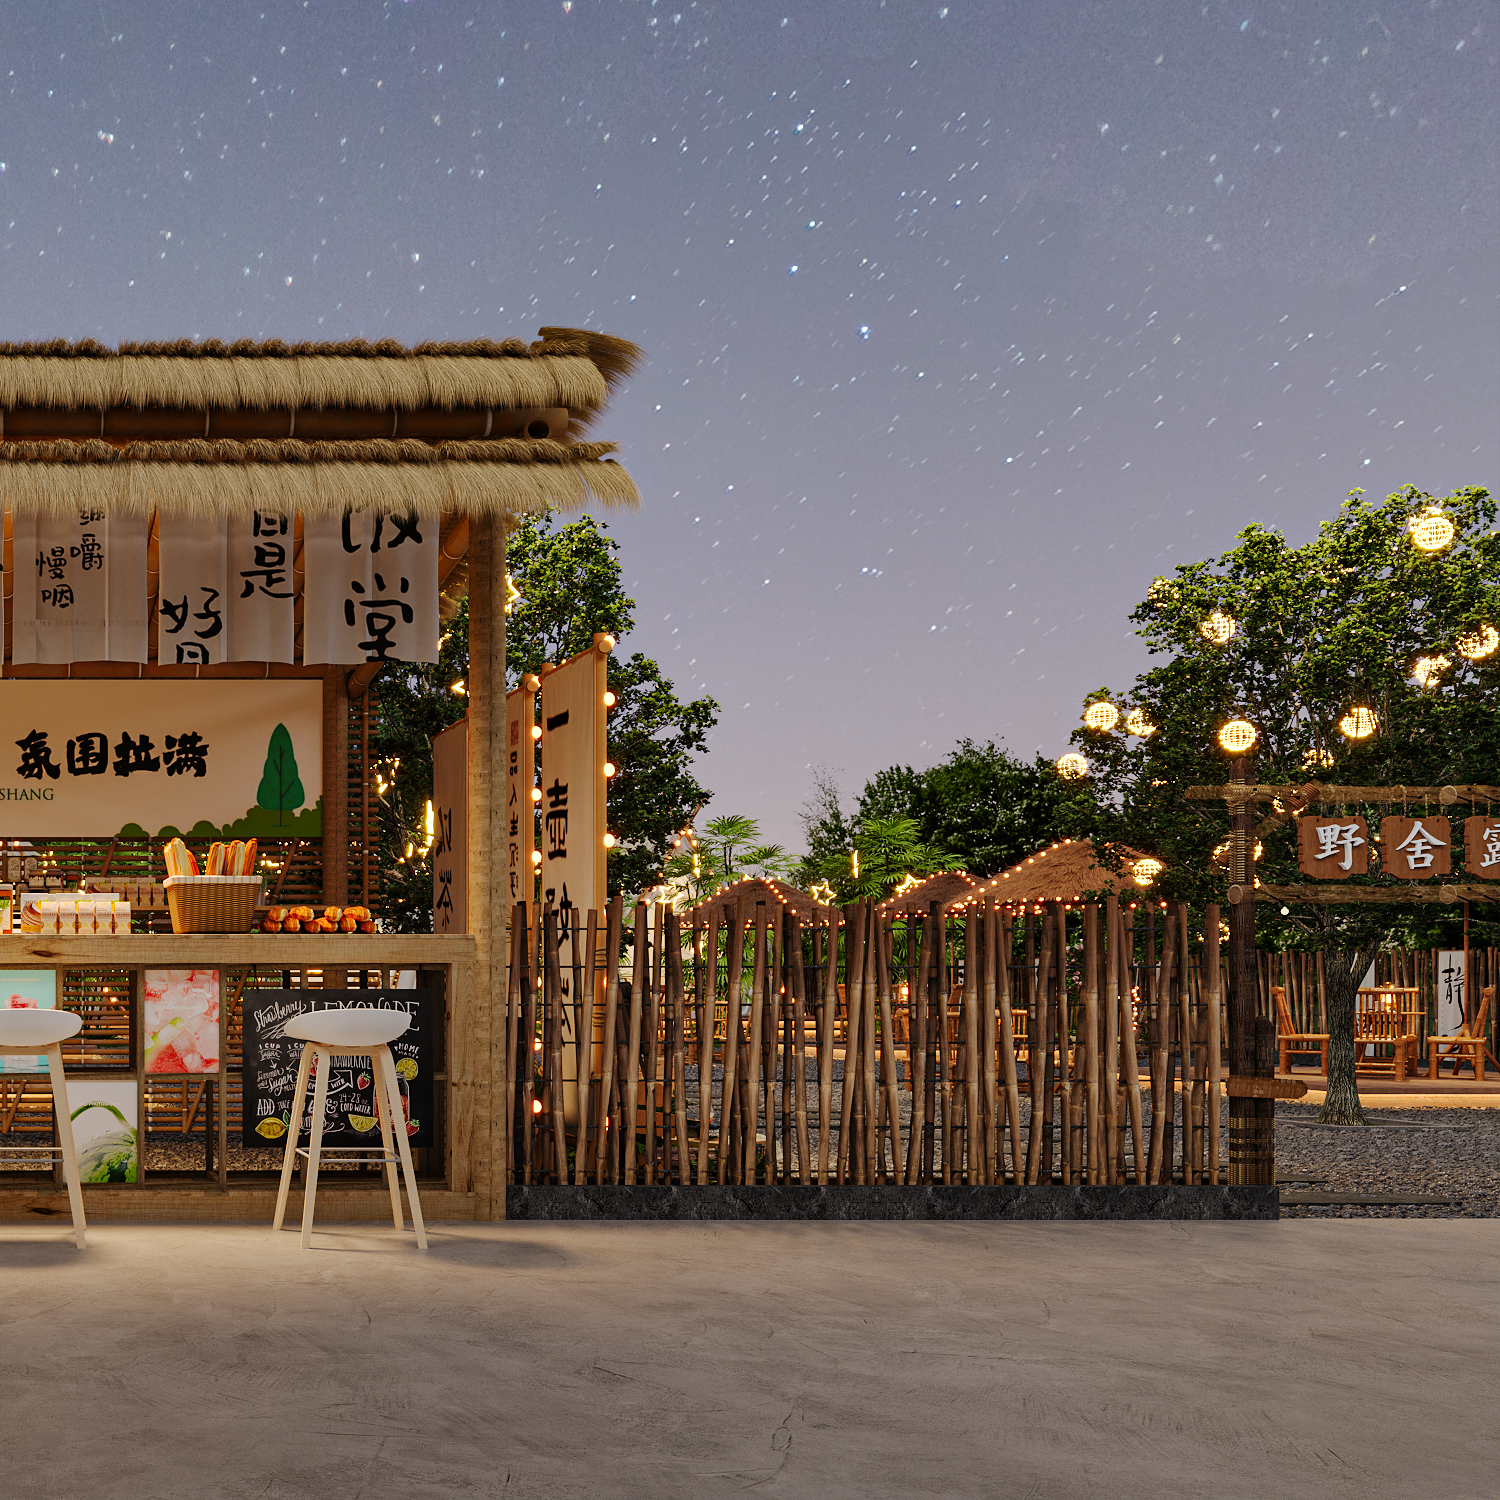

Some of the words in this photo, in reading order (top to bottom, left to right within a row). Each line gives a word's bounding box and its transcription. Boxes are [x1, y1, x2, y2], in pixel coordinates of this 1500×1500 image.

[36, 546, 75, 609] 慢咽
[15, 729, 210, 780] 氛围拉满
[264, 1042, 281, 1050] CUP
[398, 1042, 420, 1054] HOME
[256, 1098, 275, 1116] ADD
